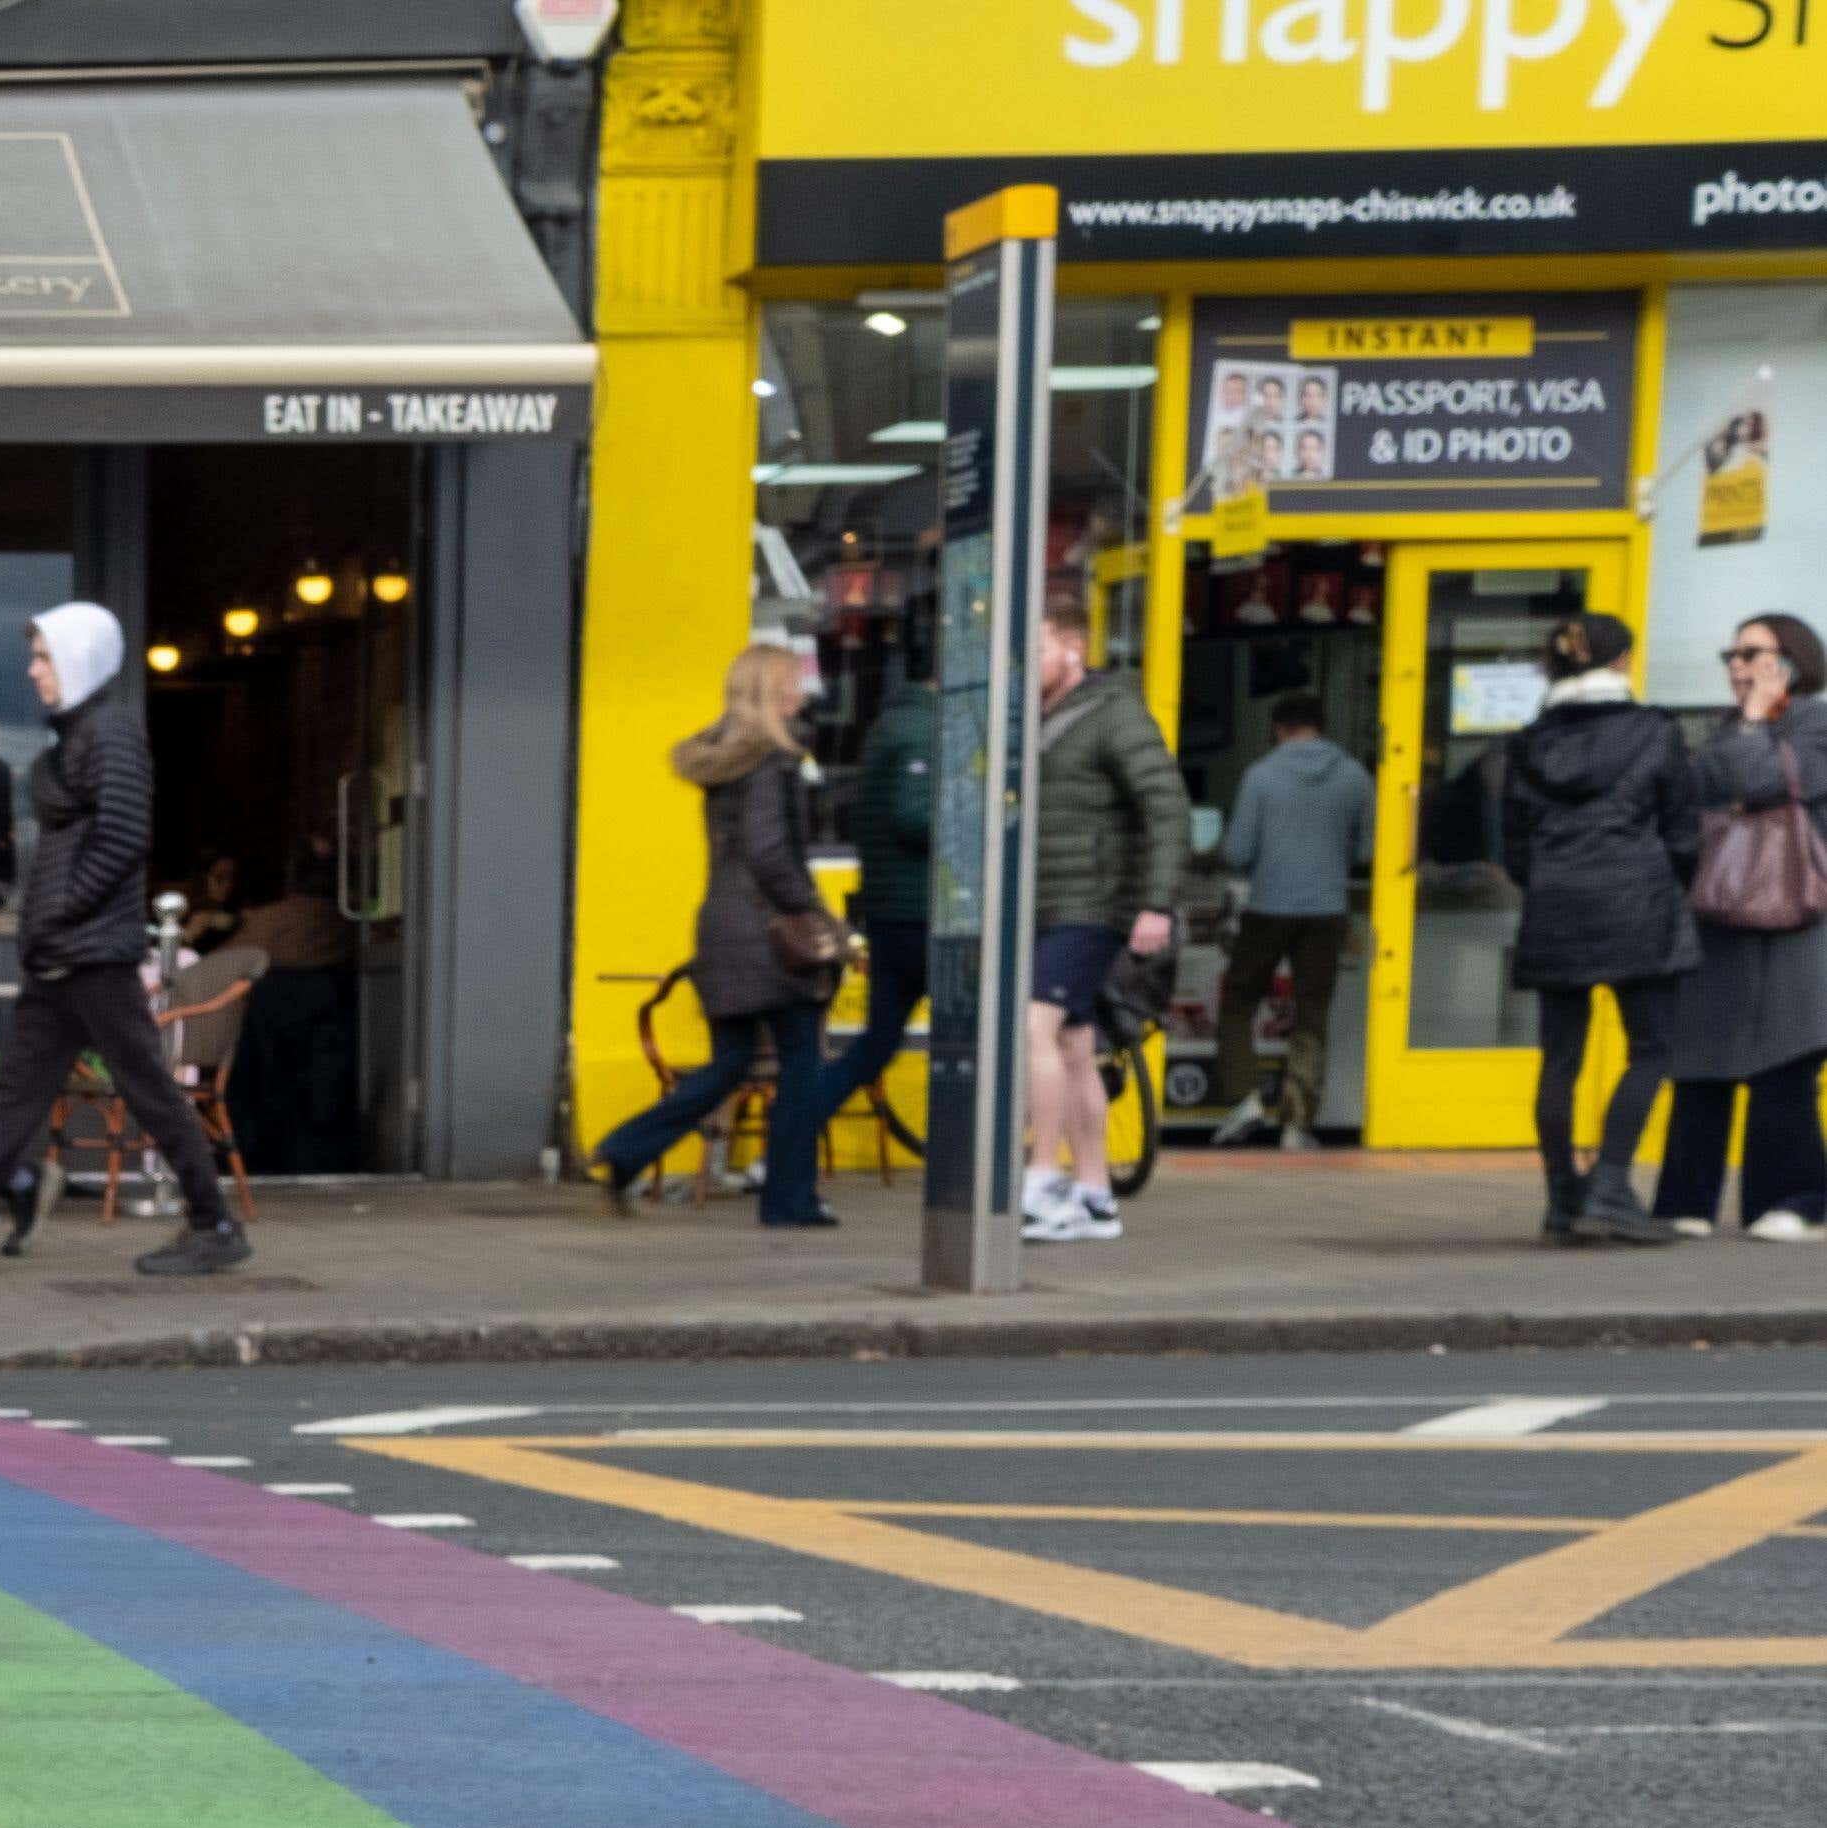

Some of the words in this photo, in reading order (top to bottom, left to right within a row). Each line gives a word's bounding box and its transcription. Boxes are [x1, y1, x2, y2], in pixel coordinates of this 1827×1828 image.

[1068, 185, 1577, 233] www.snappysnaps-chiswick.co.uk
[1692, 170, 1827, 226] photo
[1326, 322, 1494, 351] INSTANT
[263, 394, 322, 434] EAT
[326, 394, 362, 434] IN
[387, 393, 558, 434] TAKEAWAY
[1341, 377, 1522, 418] PASSPORT,
[1527, 376, 1606, 414] VISA
[1368, 428, 1399, 464] &
[1404, 427, 1444, 464] ID
[1447, 425, 1574, 463] PHOTO
